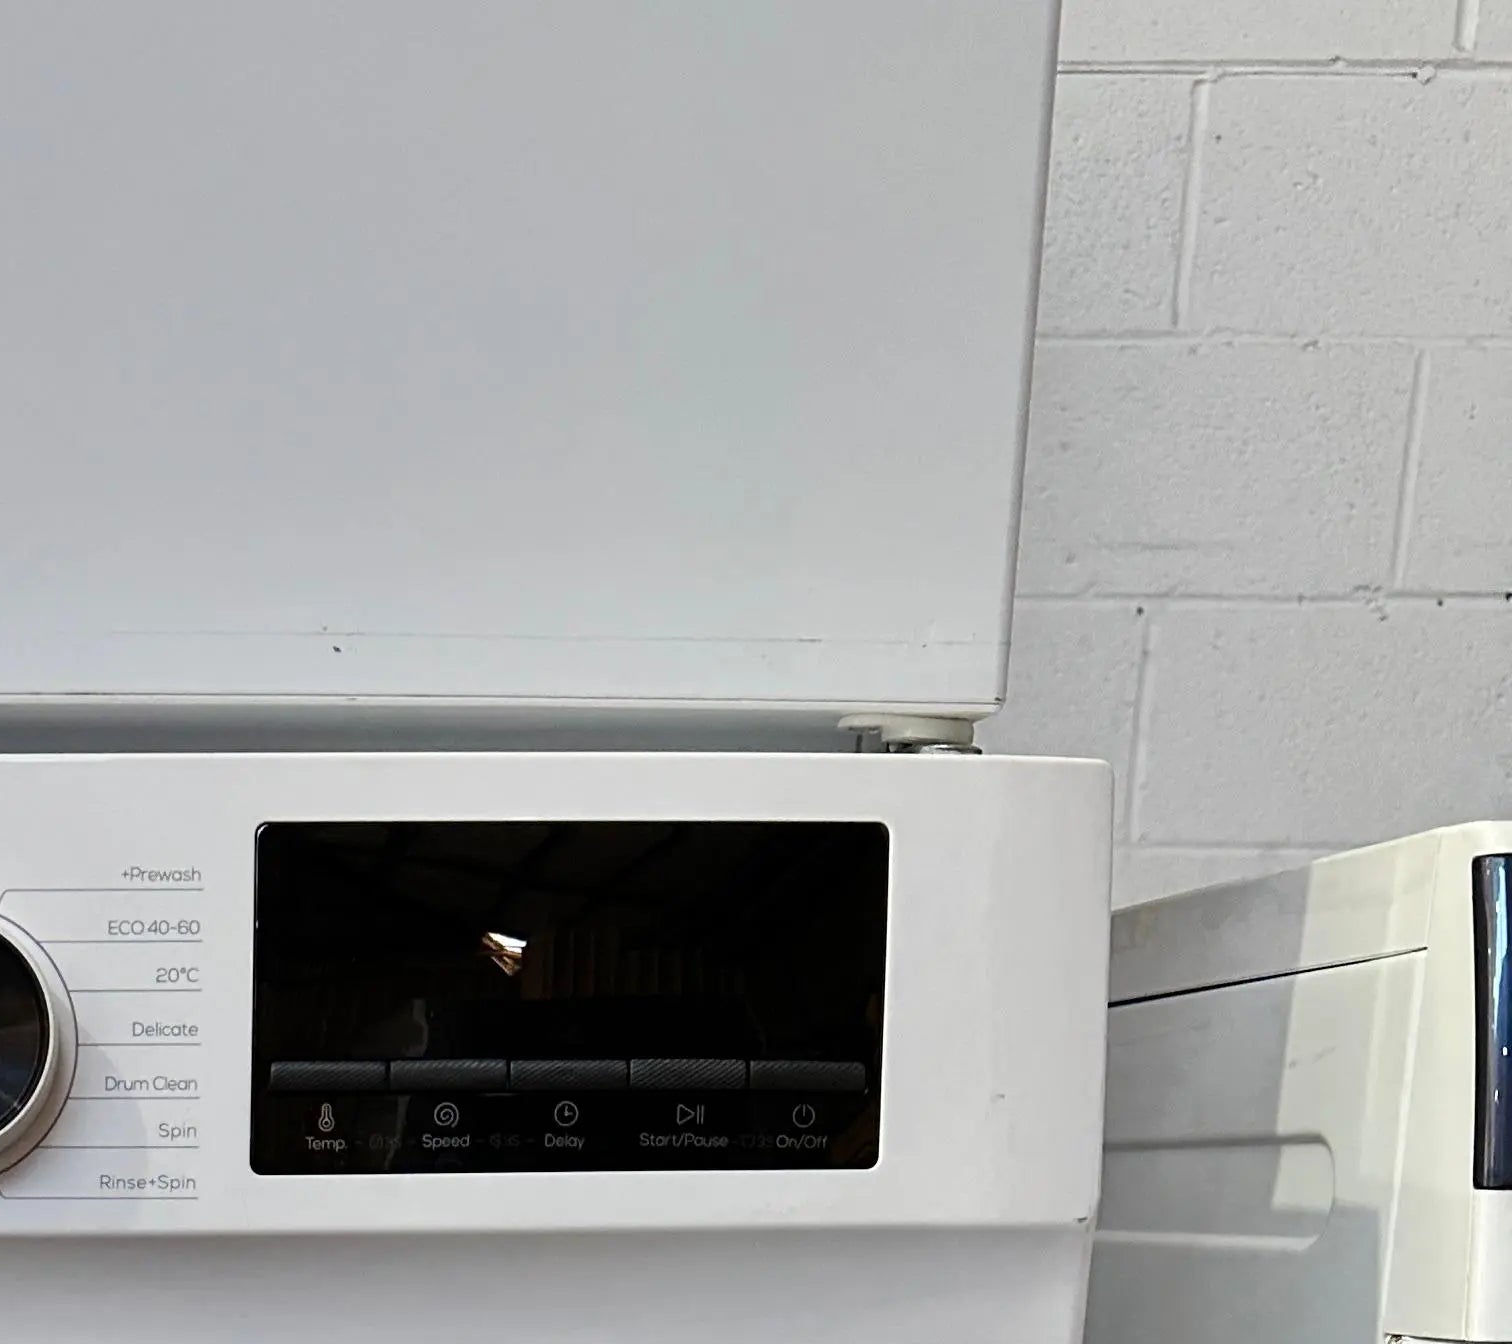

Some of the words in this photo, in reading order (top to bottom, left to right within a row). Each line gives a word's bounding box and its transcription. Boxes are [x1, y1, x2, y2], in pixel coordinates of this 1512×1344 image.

[121, 866, 202, 882] +Prewash
[107, 920, 146, 936] ECO
[147, 919, 201, 936] 40-60
[155, 967, 200, 984] 20°C
[131, 1021, 199, 1038] Delicate
[104, 1075, 149, 1092] Drum
[152, 1075, 198, 1092] Clean
[158, 1122, 198, 1142] Spin
[639, 1132, 729, 1148] Start/Pause
[421, 1133, 471, 1151] Speed
[544, 1133, 585, 1151] Delay
[775, 1134, 828, 1150] On/Off
[99, 1174, 196, 1193] Rinse+Spin
